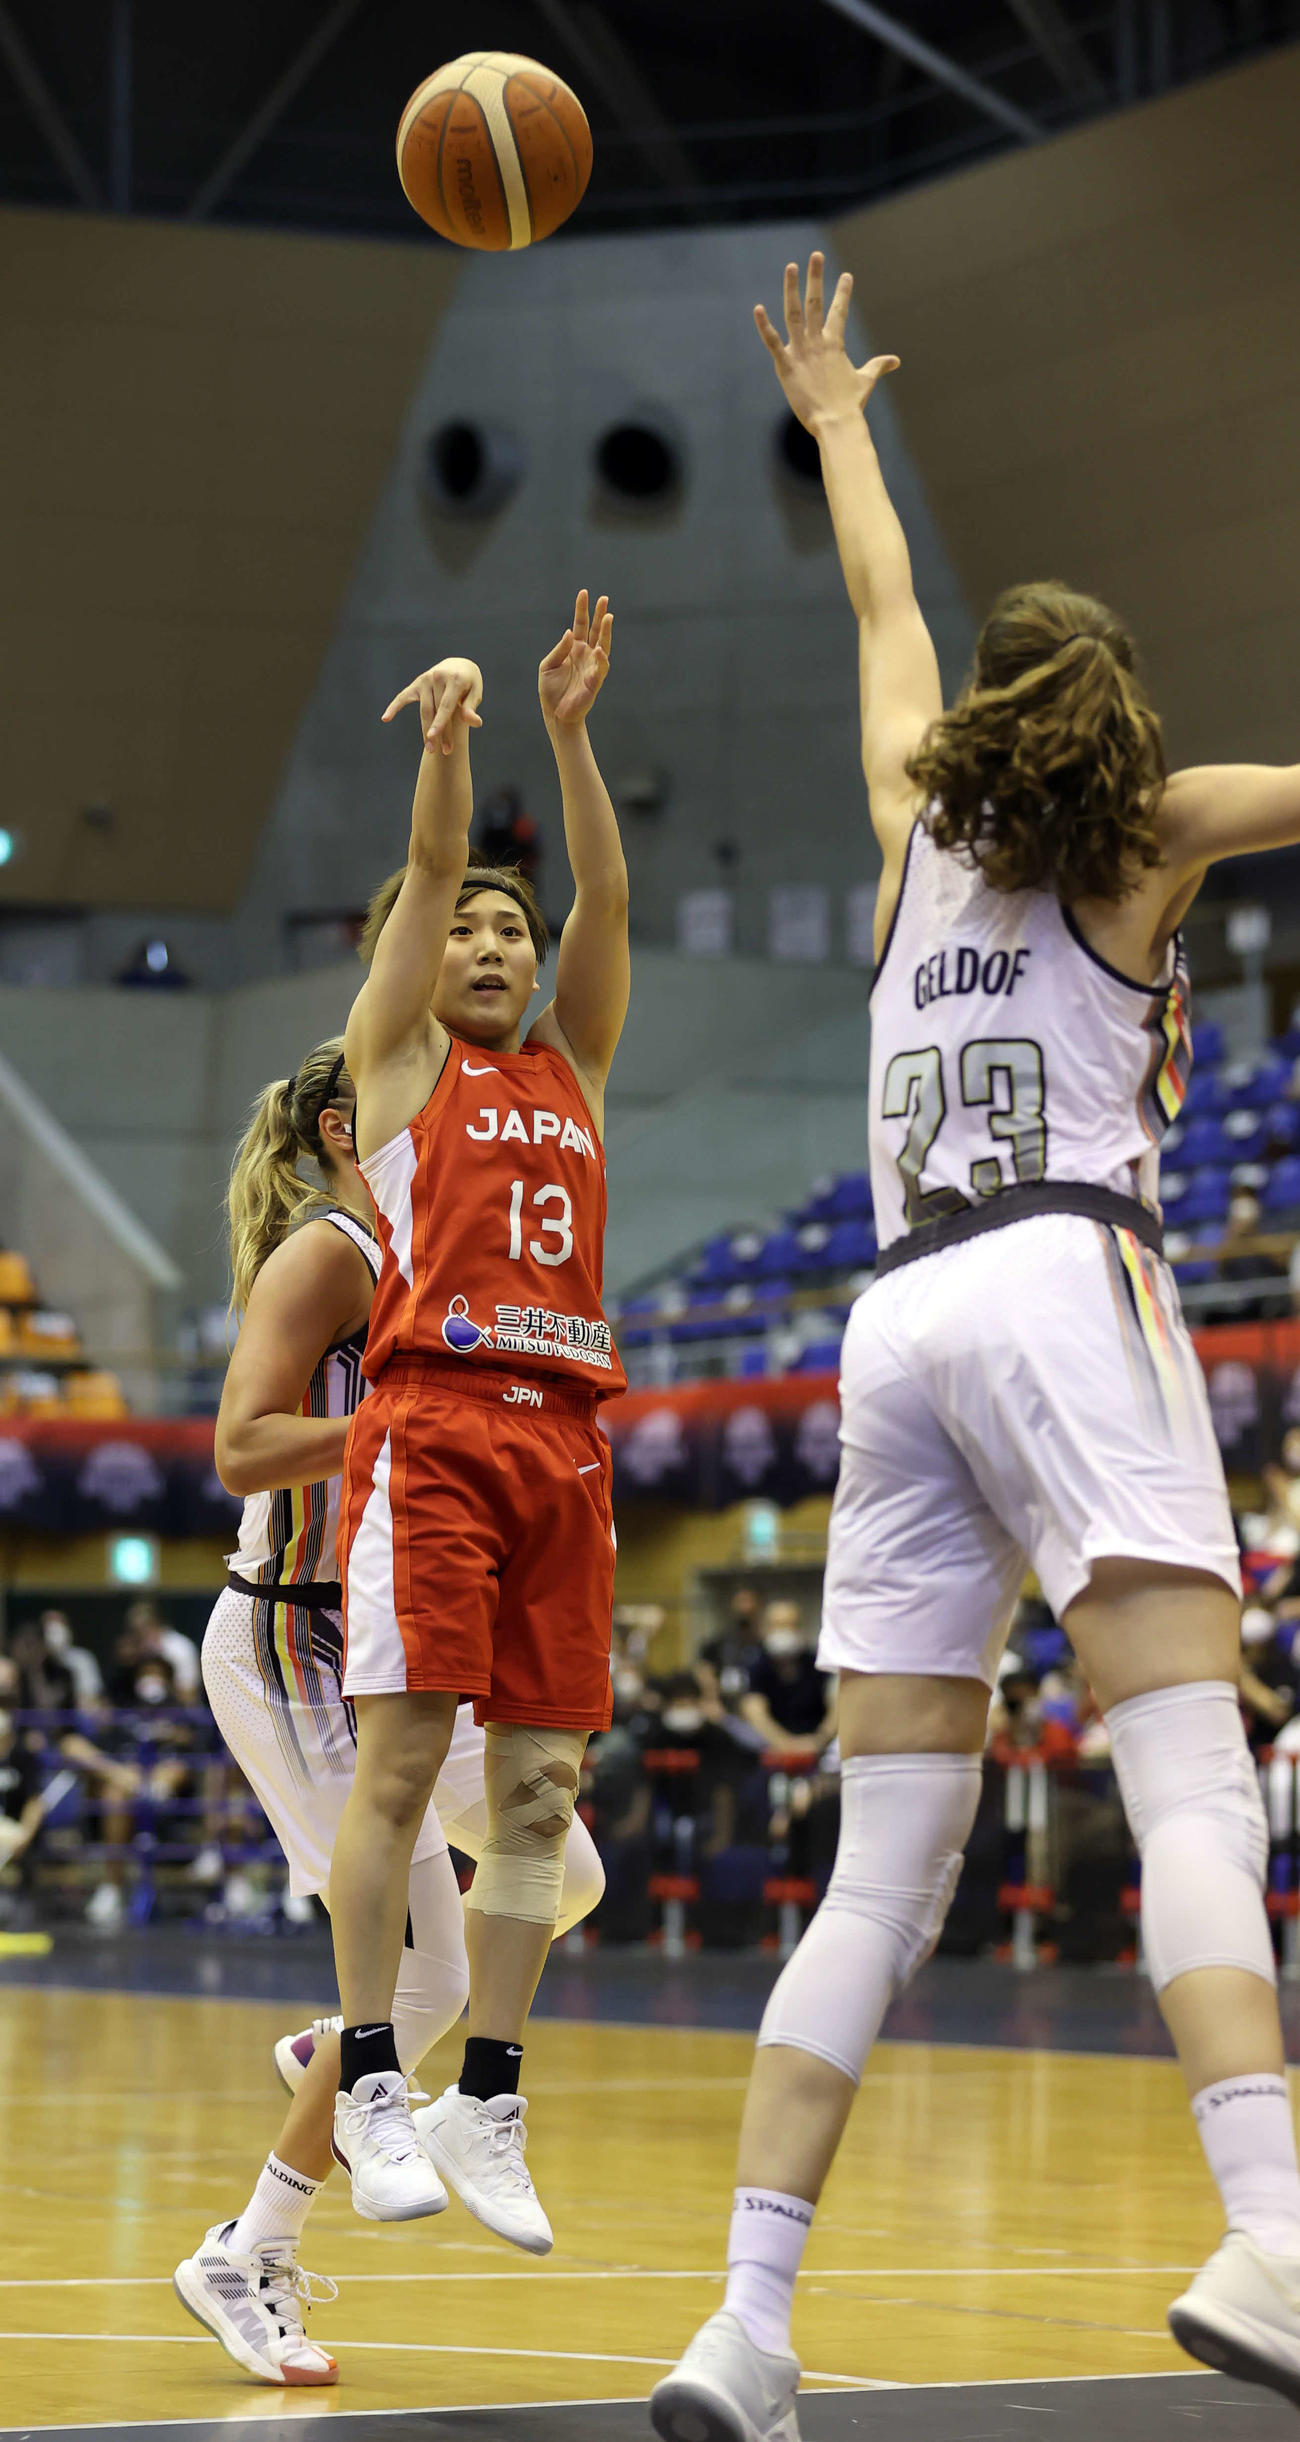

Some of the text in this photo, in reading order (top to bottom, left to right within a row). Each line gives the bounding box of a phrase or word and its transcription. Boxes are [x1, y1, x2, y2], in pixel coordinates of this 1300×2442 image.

[914, 947, 1031, 1010] GELDOF
[465, 1107, 596, 1160] JAPAN
[882, 1038, 1047, 1228] 23
[508, 1180, 574, 1267] 13
[495, 1305, 611, 1352] 三井不動産
[496, 1334, 613, 1370] MITSUI FUDOSAN
[502, 1386, 544, 1408] JPN
[266, 2161, 316, 2196] ALDING
